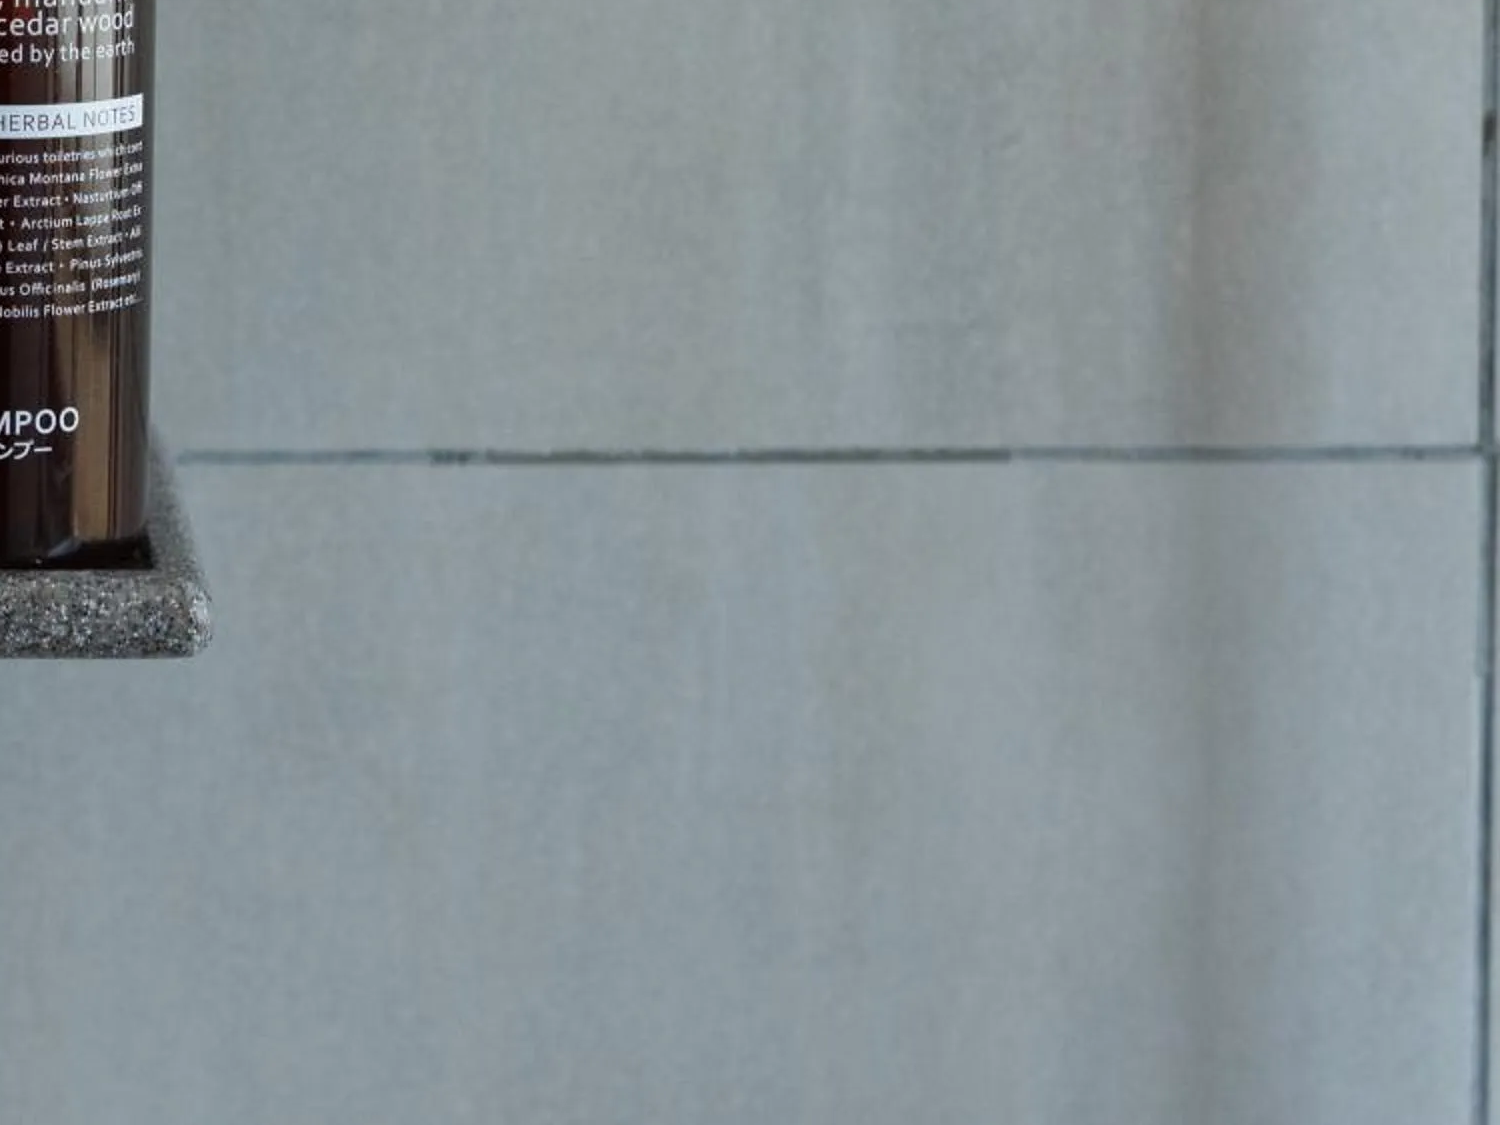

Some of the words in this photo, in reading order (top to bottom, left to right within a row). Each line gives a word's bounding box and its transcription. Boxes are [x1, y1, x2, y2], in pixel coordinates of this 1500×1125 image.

[78, 3, 134, 33] wood
[29, 44, 54, 68] by
[59, 41, 91, 62] the
[95, 37, 135, 58] earth
[83, 105, 136, 130] NOTES
[29, 171, 85, 186] Montana
[13, 194, 62, 208] Extract
[20, 216, 73, 230] Arctium
[7, 238, 39, 252] Leaf
[51, 238, 85, 251] Stem
[87, 233, 123, 248] Extract
[5, 260, 55, 274] Extract
[69, 257, 102, 271] Pinus
[19, 280, 86, 295] Officinalis
[43, 302, 86, 316] Flower
[88, 296, 123, 313] Extract
